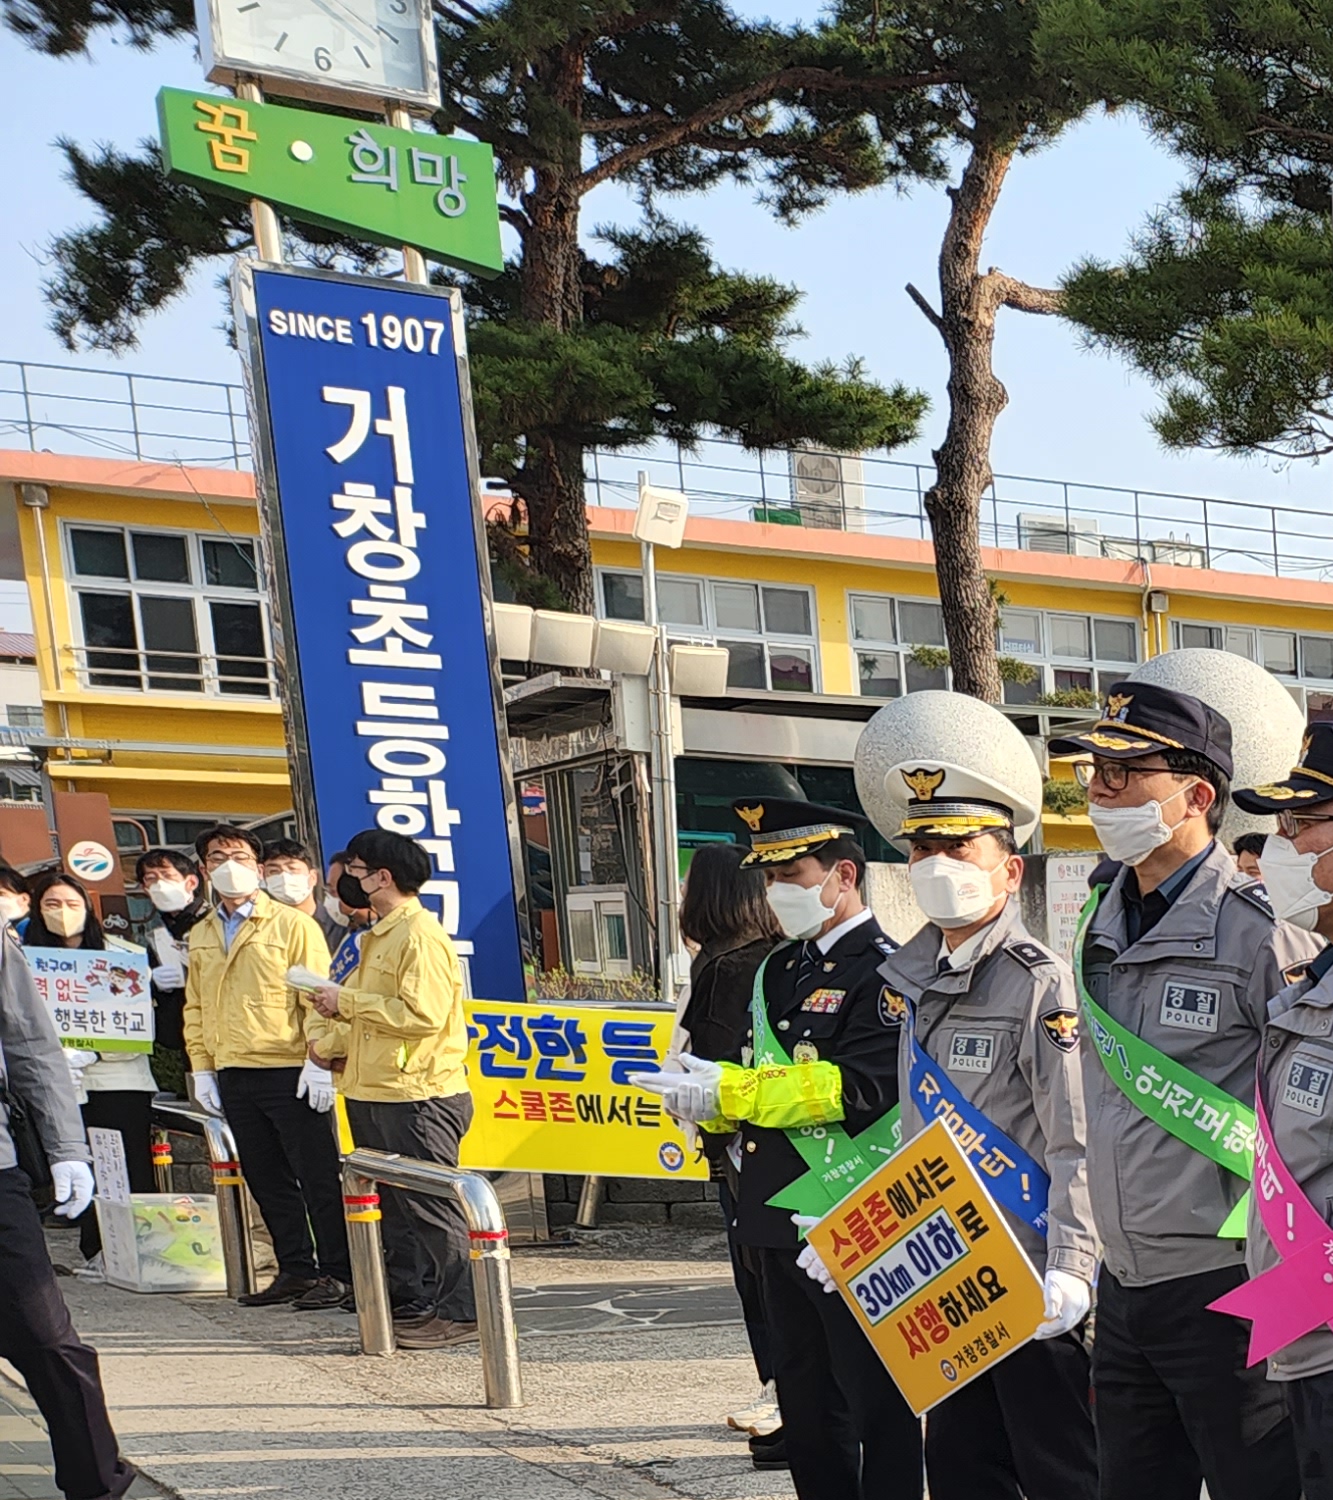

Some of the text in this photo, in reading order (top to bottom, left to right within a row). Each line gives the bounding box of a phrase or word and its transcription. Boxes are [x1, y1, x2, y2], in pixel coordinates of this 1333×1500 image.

[314, 46, 333, 71] 6
[197, 100, 467, 219] 꿈 희망
[269, 309, 445, 356] SINCE 1907
[56, 978, 90, 1004] 없는
[54, 1007, 147, 1035] 행복한 학교
[1165, 1009, 1214, 1028] POLICE
[467, 1013, 588, 1082] 전한
[952, 1057, 989, 1070] POLICE
[493, 1089, 662, 1128] 스쿨존에서는
[1285, 1089, 1321, 1112] POLICE
[829, 1154, 957, 1271] 스쿨존에서는
[855, 1262, 914, 1319] 30km
[905, 1213, 960, 1275] 이하
[895, 1264, 1008, 1361] 서행하세요
[953, 1321, 1011, 1371] 거창경찰서
